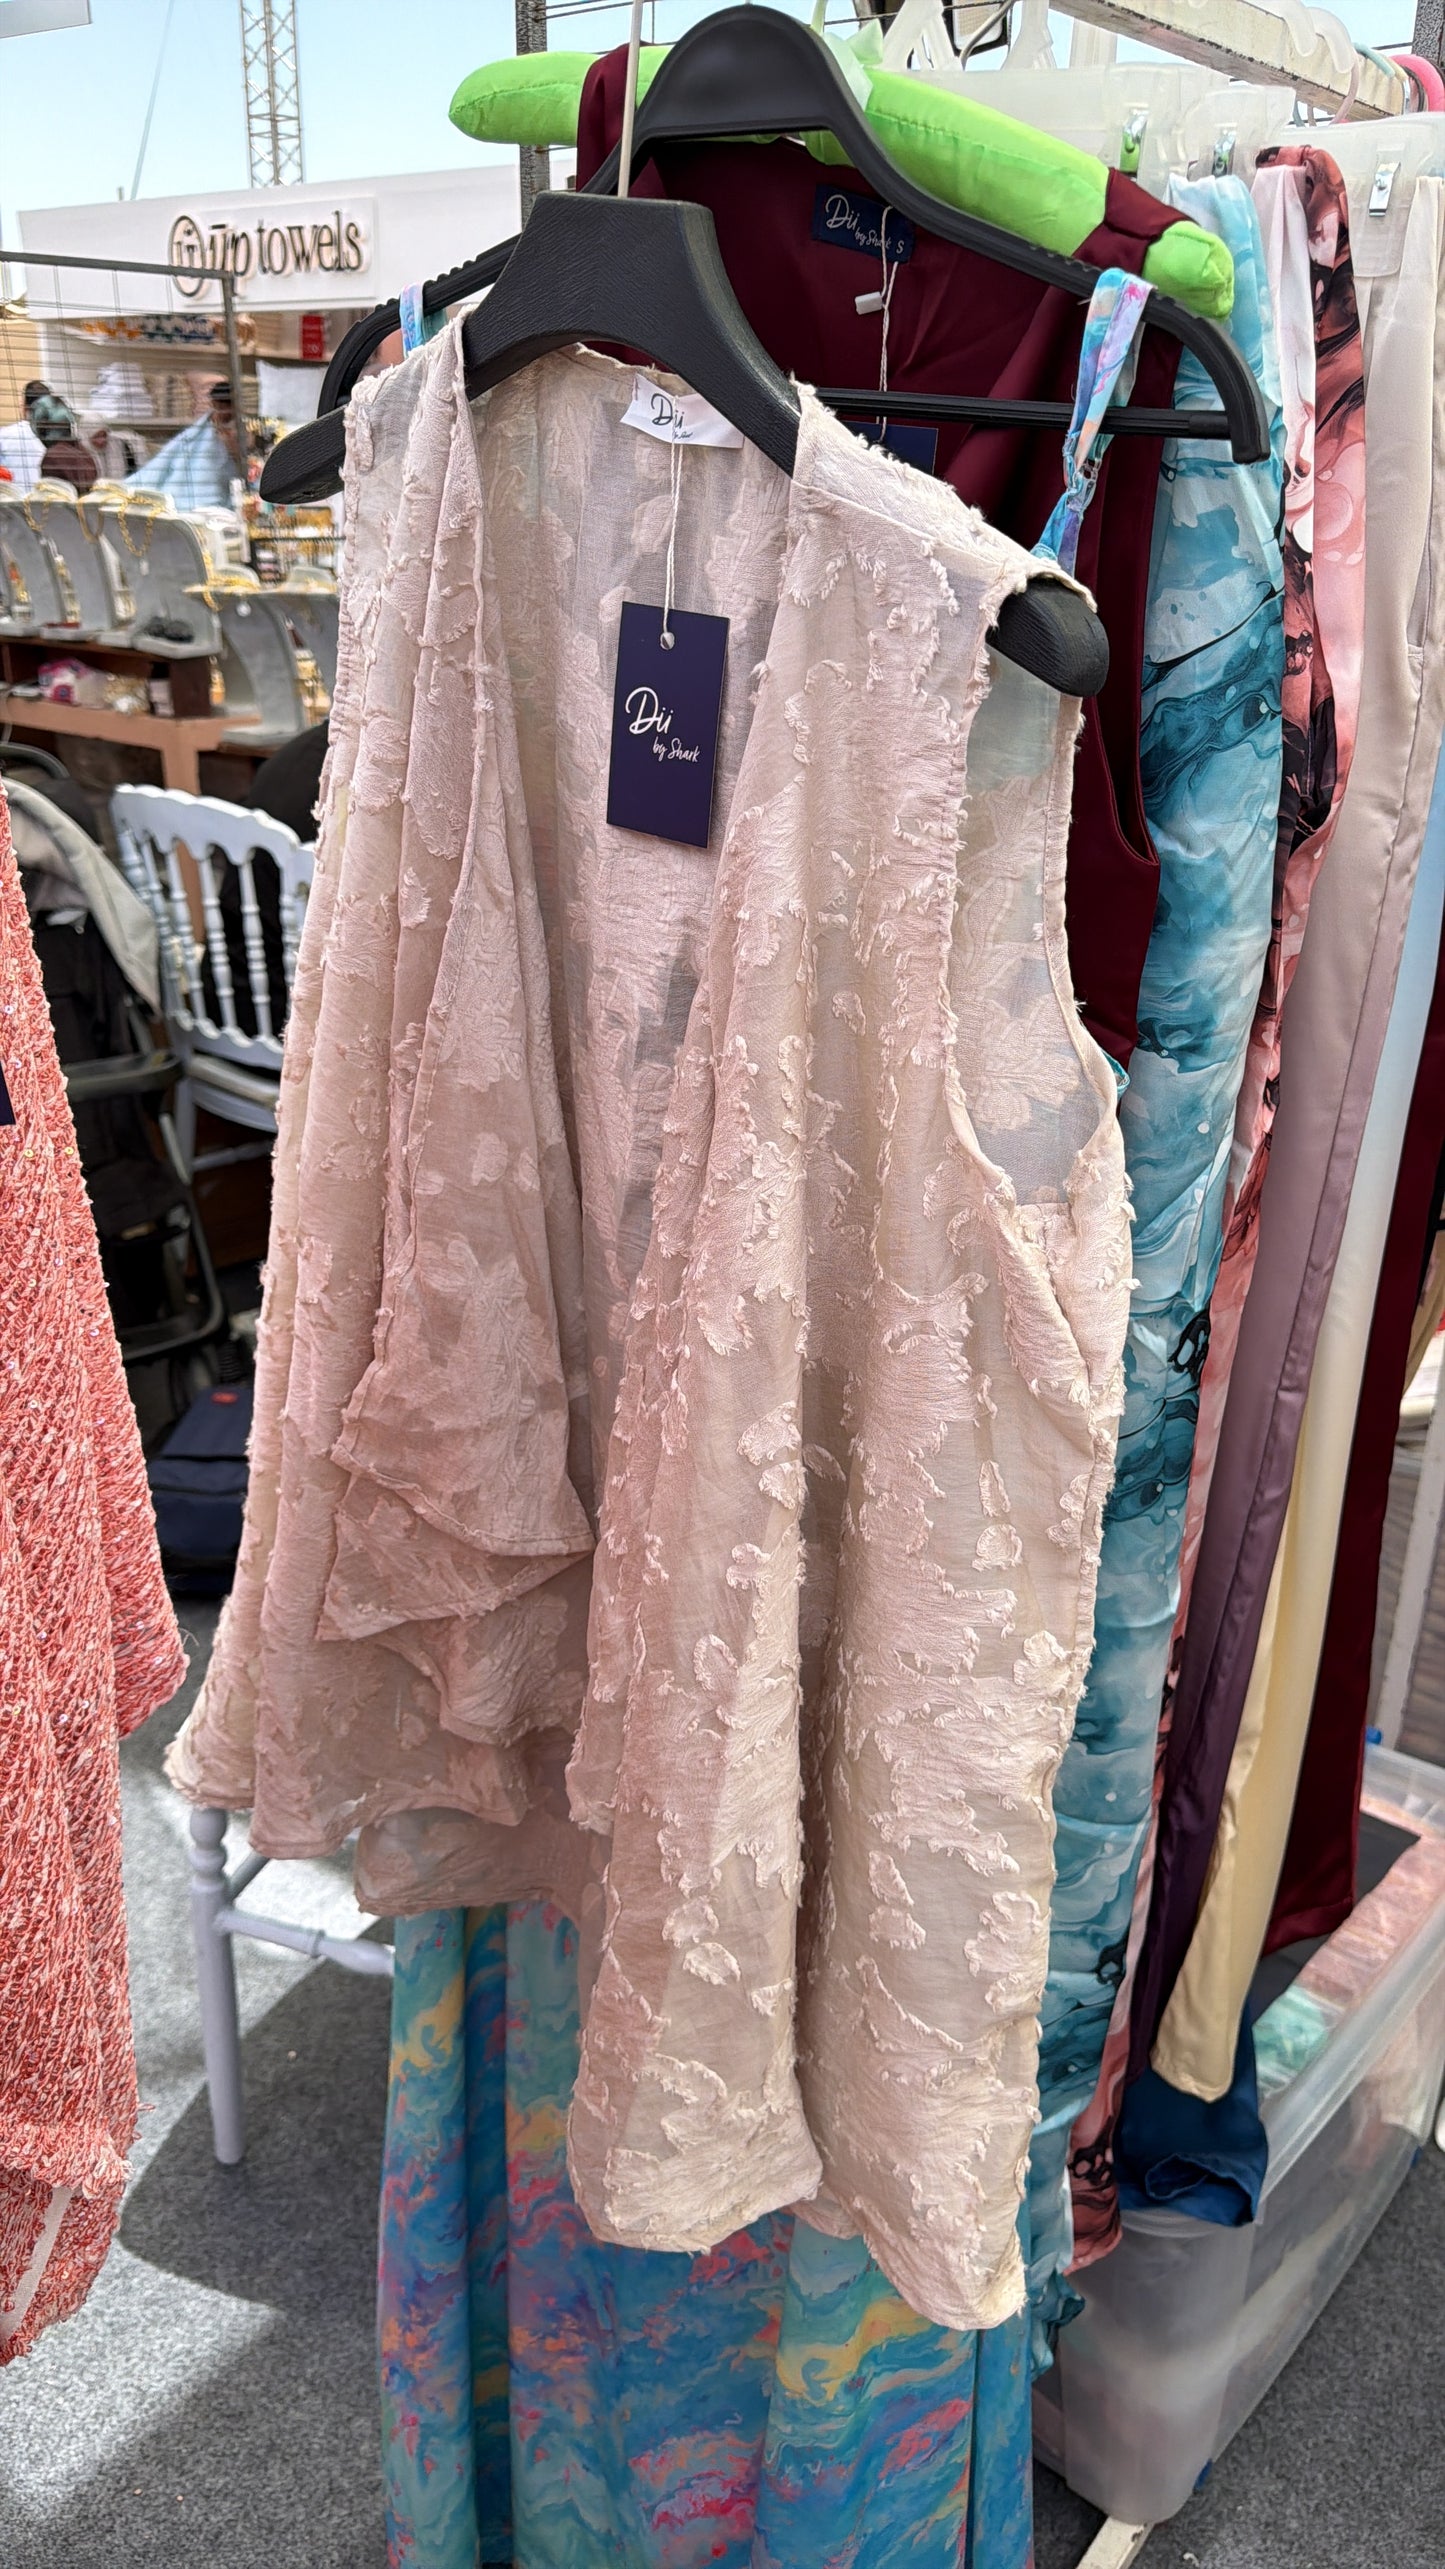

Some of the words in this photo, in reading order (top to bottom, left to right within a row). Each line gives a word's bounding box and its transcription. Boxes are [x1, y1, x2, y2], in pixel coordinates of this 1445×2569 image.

[854, 227, 867, 246] by
[865, 229, 892, 250] Shak
[896, 240, 905, 254] S
[652, 736, 667, 762] by
[667, 737, 700, 763] Shark
